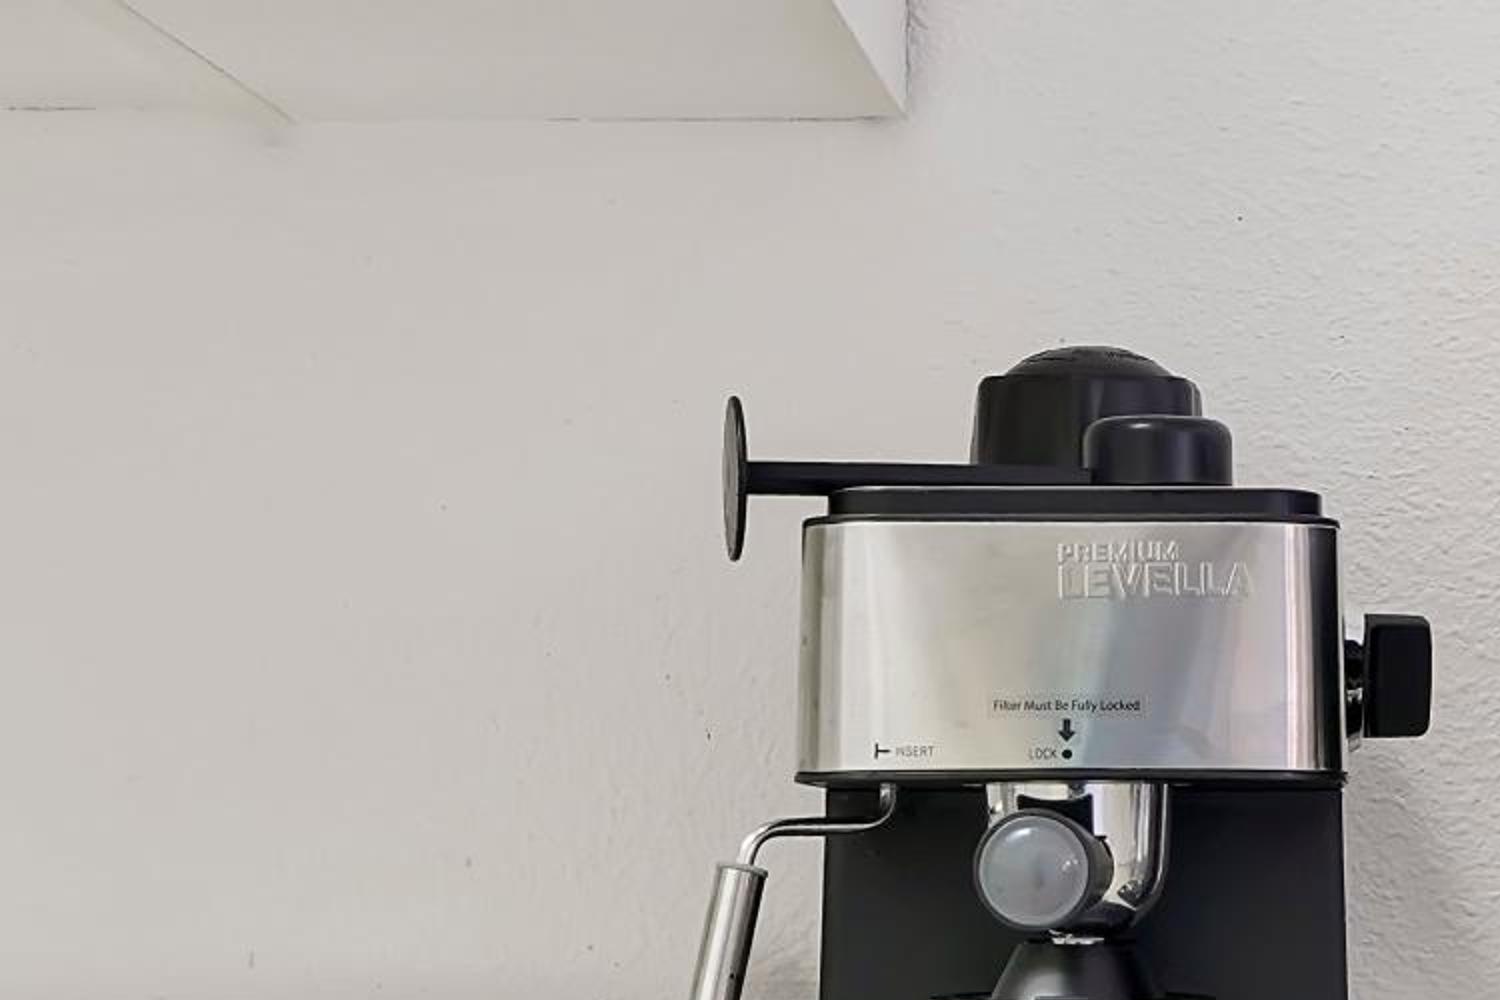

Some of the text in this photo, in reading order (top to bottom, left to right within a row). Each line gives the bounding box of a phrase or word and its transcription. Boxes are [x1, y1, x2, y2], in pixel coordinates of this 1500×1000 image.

[1056, 541, 1179, 562] PREMIUM
[1057, 562, 1255, 600] LEVELLA
[993, 700, 1141, 713] Filter Must Be Fully Locked
[1028, 748, 1058, 760] LOCK
